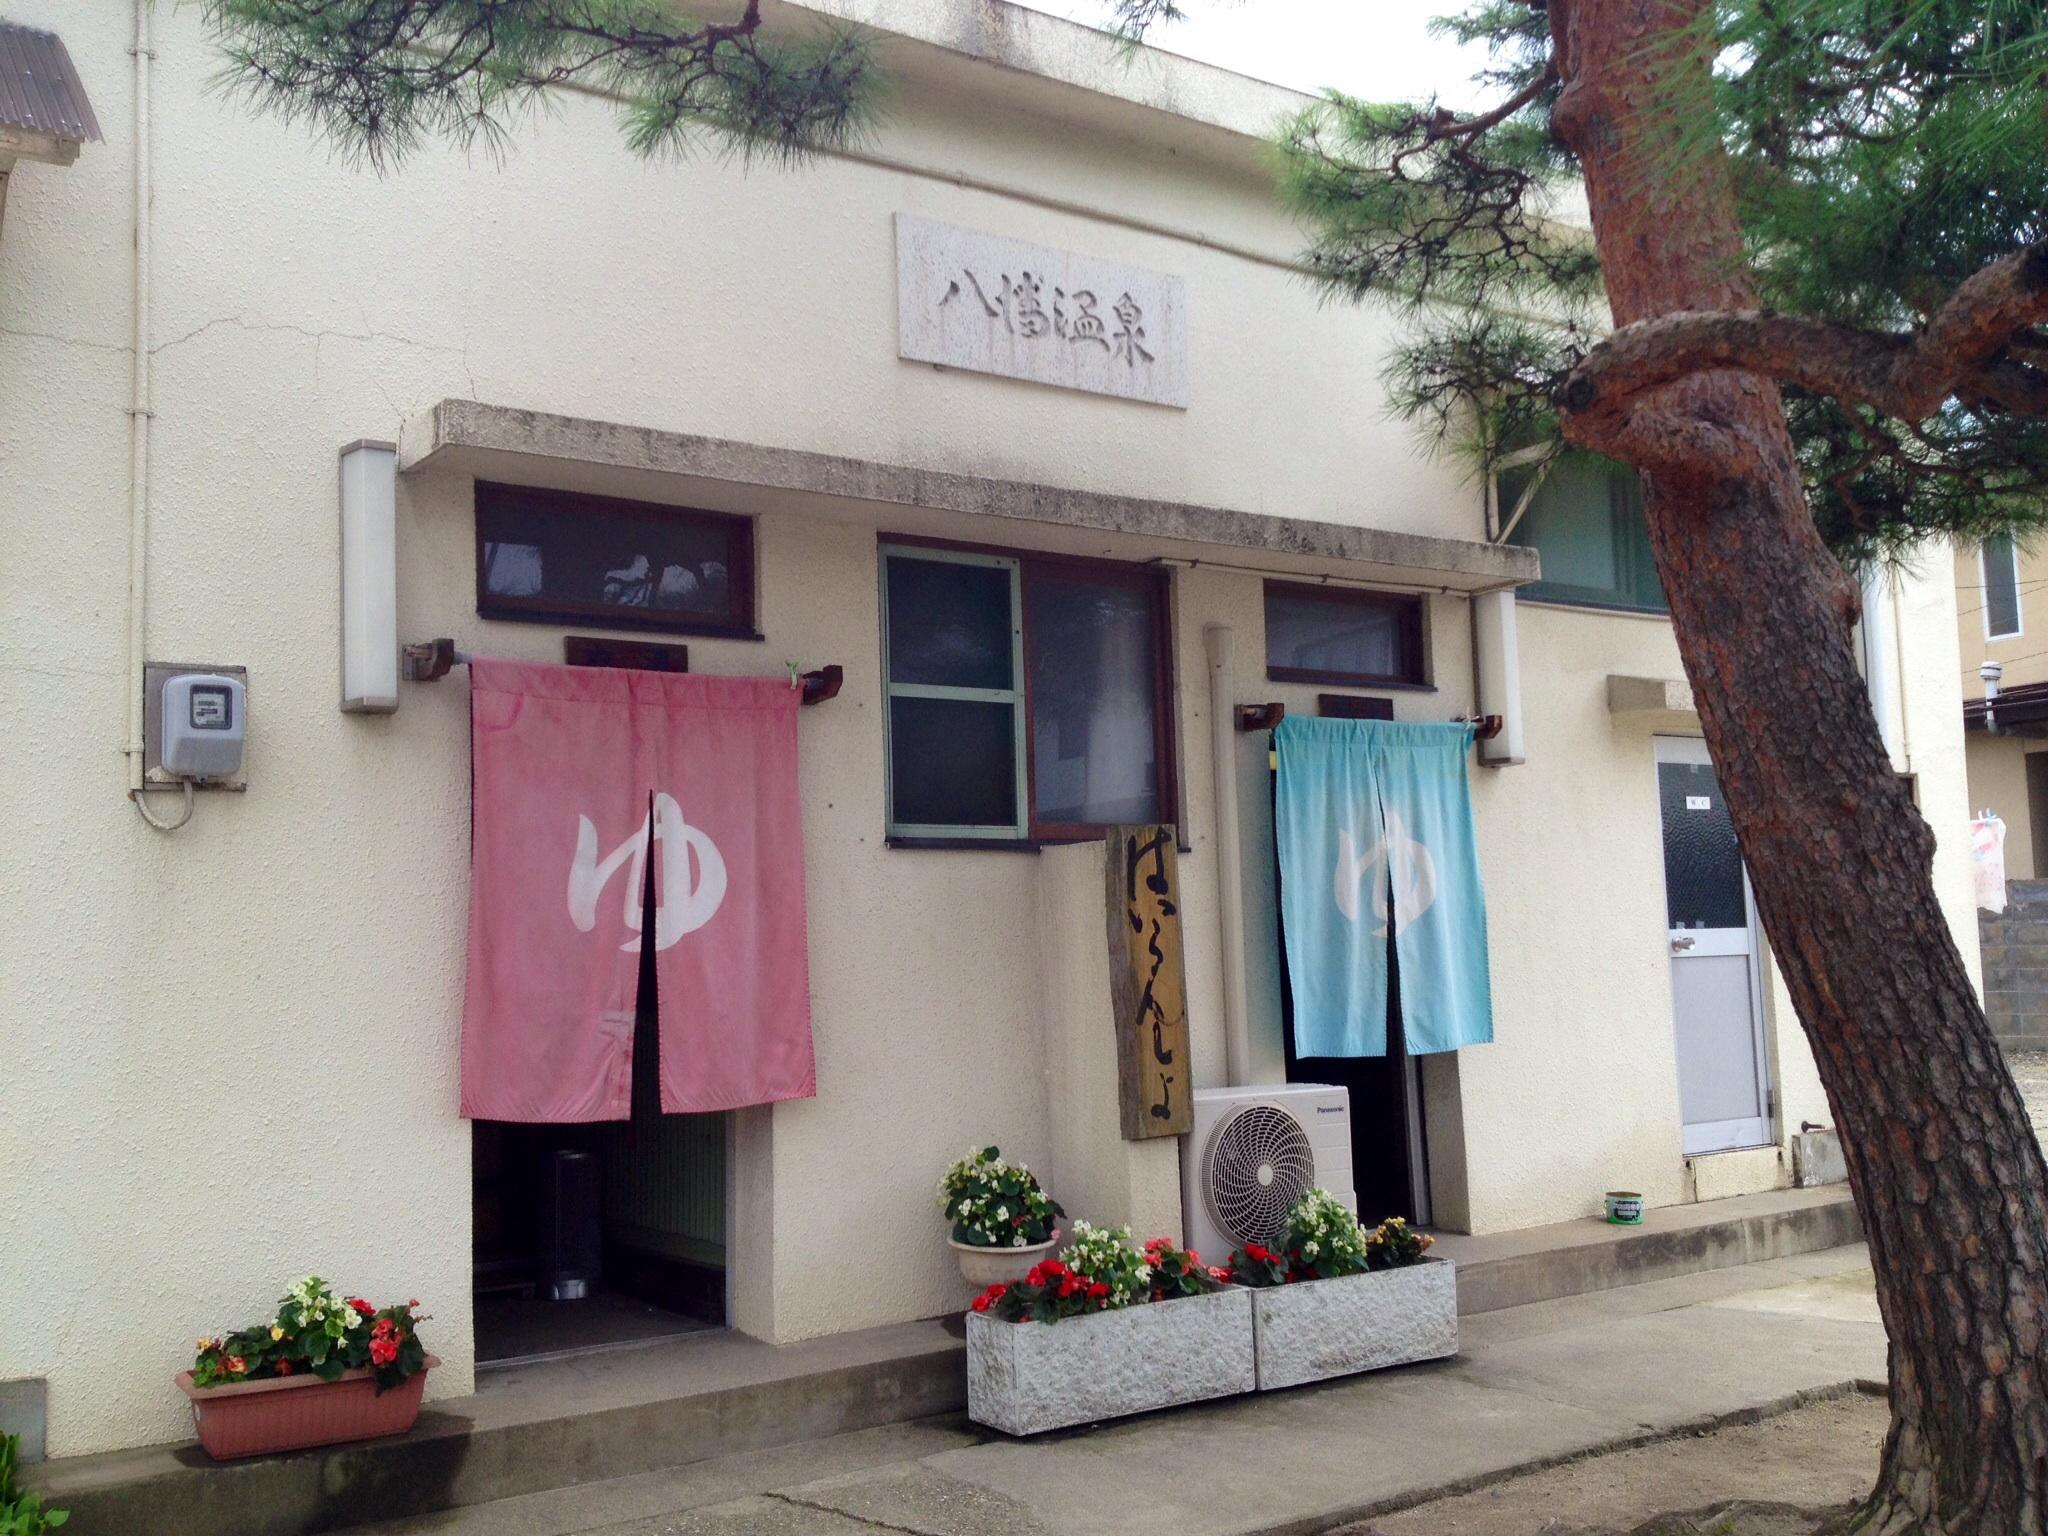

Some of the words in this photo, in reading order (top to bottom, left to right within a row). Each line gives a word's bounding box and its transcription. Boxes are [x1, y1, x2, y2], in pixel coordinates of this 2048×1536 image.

[567, 792, 728, 953] ゆ
[1334, 810, 1437, 938] ゆ
[1316, 1104, 1345, 1114] Panasonic
